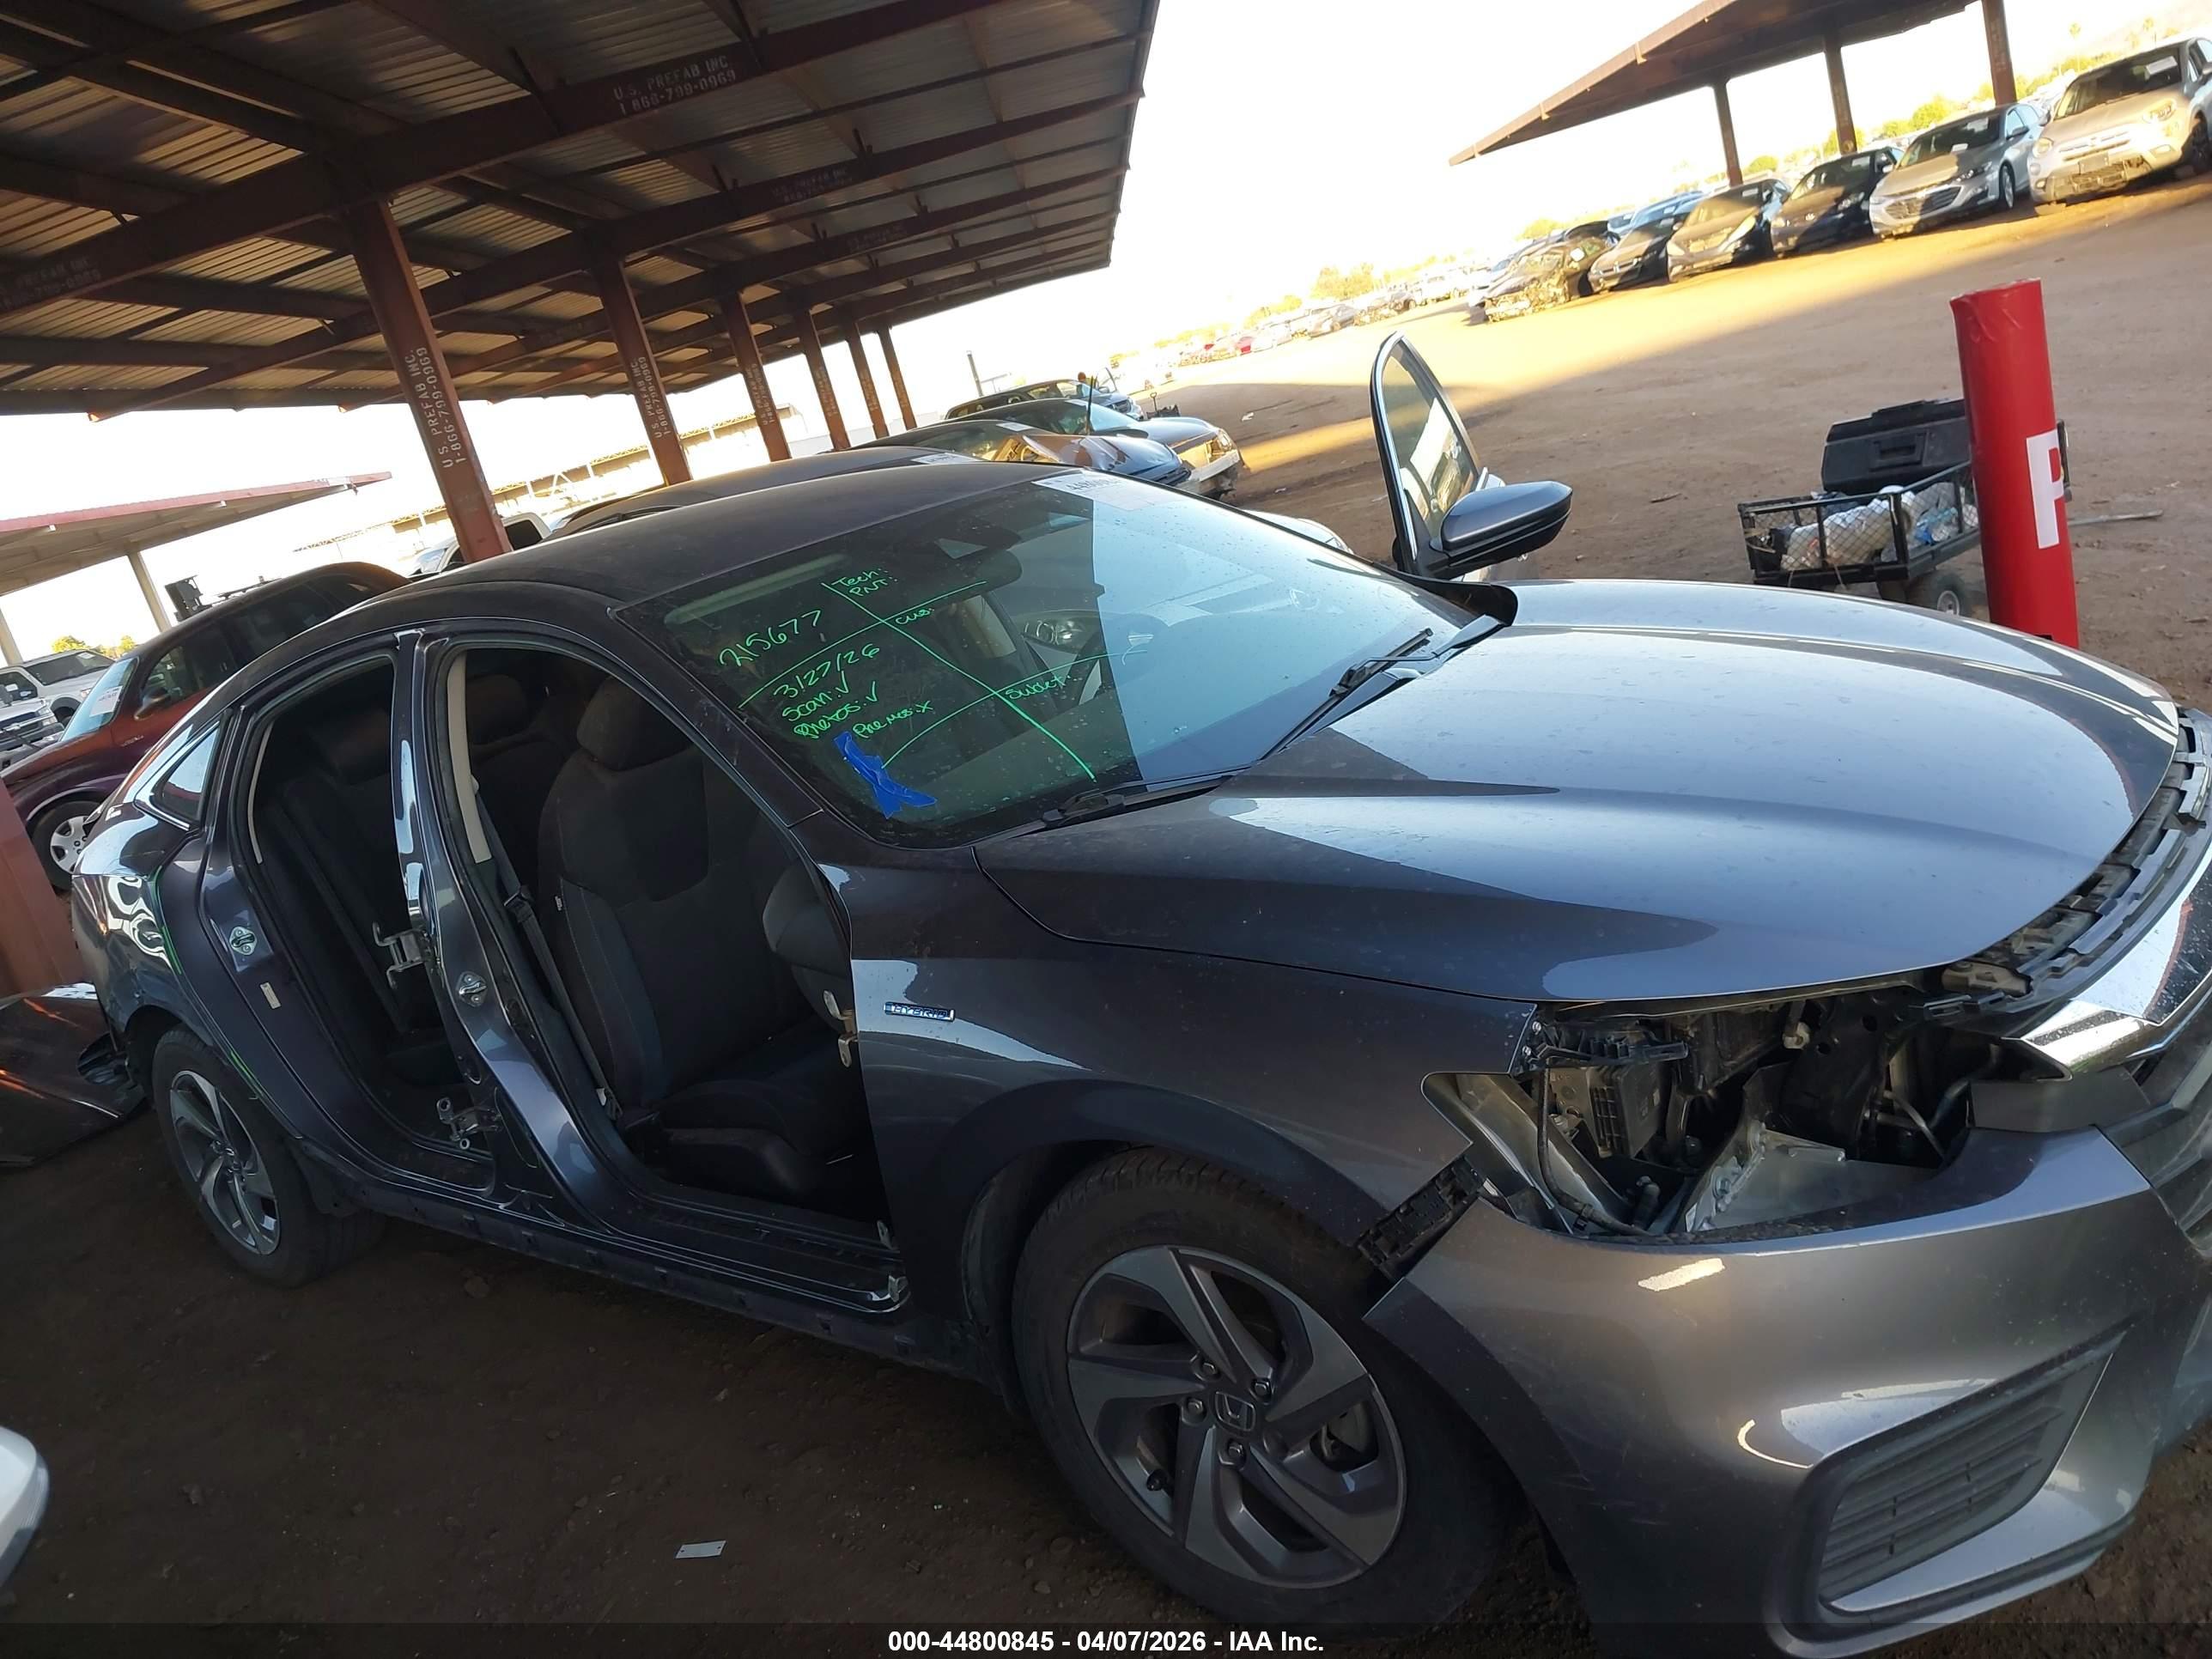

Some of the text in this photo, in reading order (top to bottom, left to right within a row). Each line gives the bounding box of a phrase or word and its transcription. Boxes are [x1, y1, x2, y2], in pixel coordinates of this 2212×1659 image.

[647, 64, 700, 91] PREFAB
[415, 383, 442, 436] PREFAB
[416, 347, 467, 464] 1-866-799-0969
[637, 380, 655, 417] PREFAB
[719, 610, 822, 667] 215677
[893, 1003, 949, 1020] HYBRID
